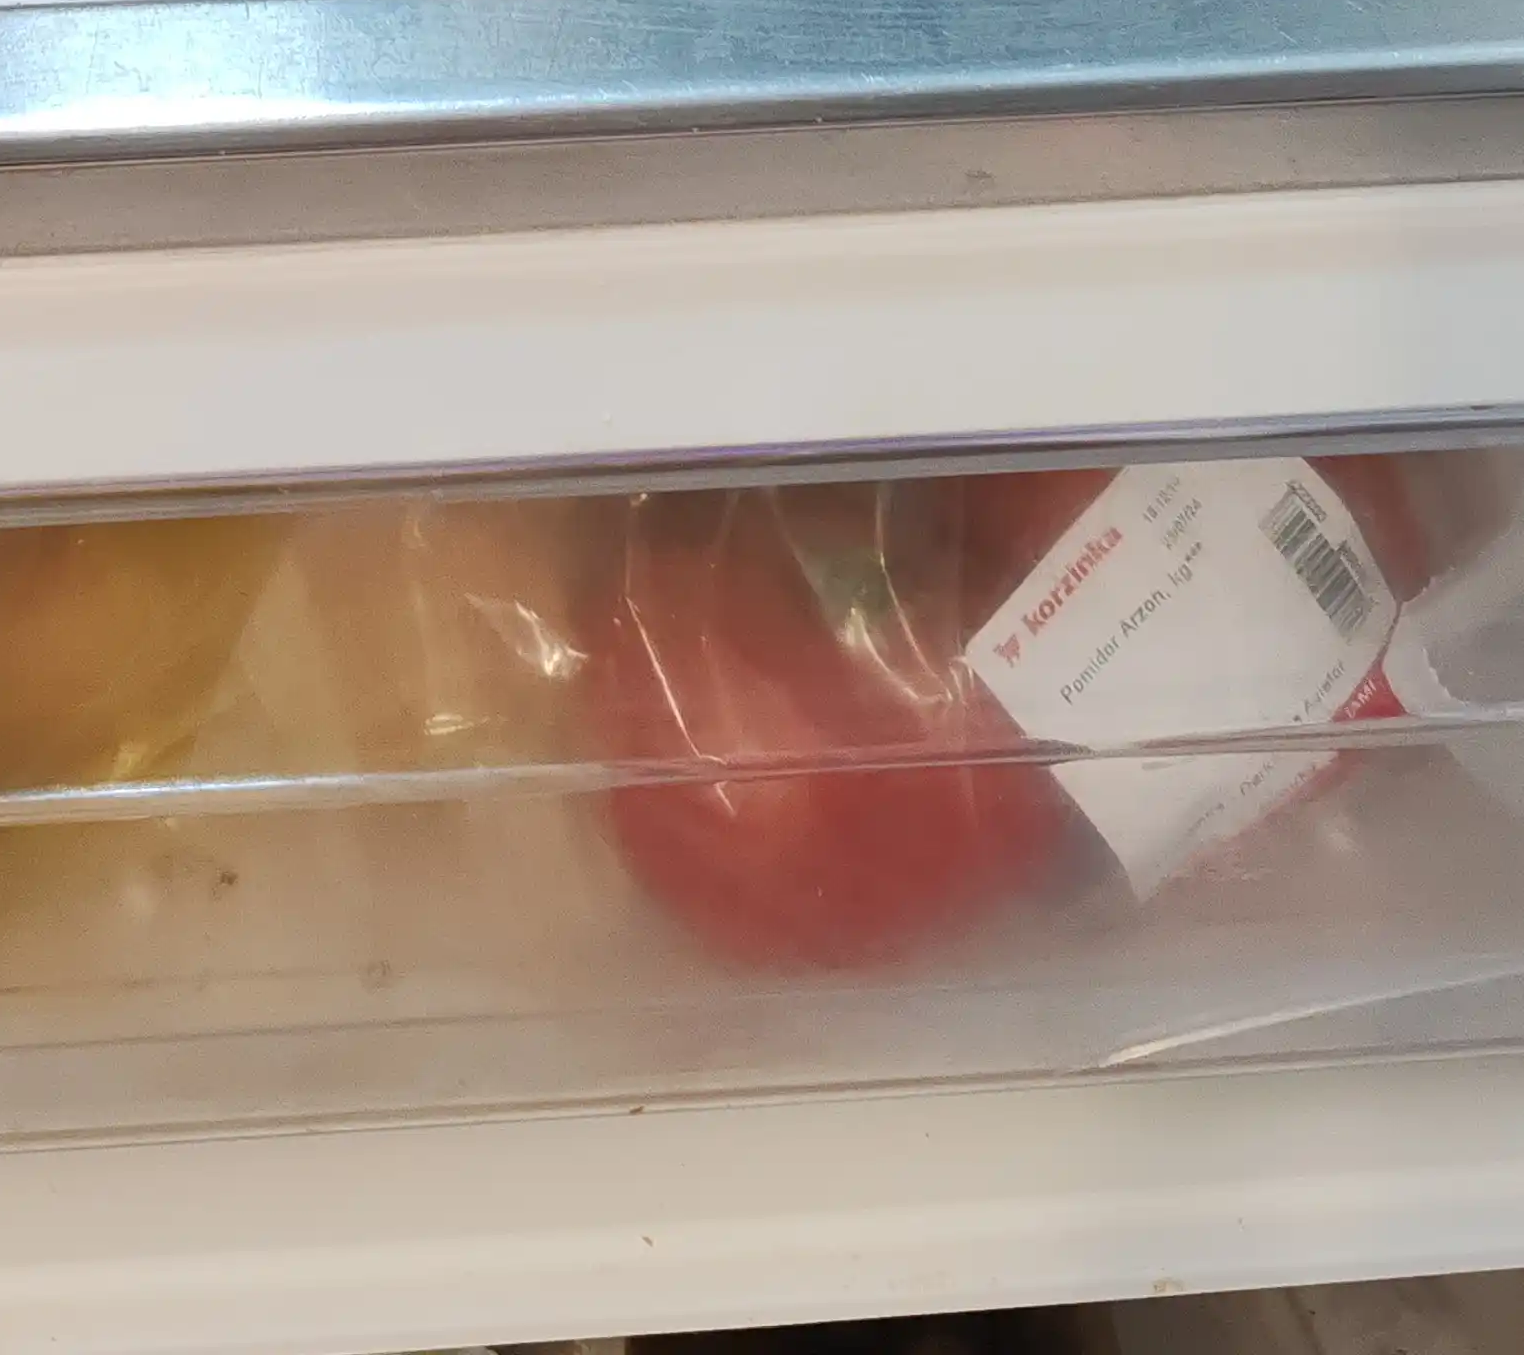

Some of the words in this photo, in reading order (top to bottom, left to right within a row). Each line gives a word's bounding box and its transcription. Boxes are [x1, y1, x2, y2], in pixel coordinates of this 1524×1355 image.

[1022, 527, 1122, 635] korzinka
[1059, 635, 1121, 707] Pomidor
[1119, 590, 1172, 639] Arzon,
